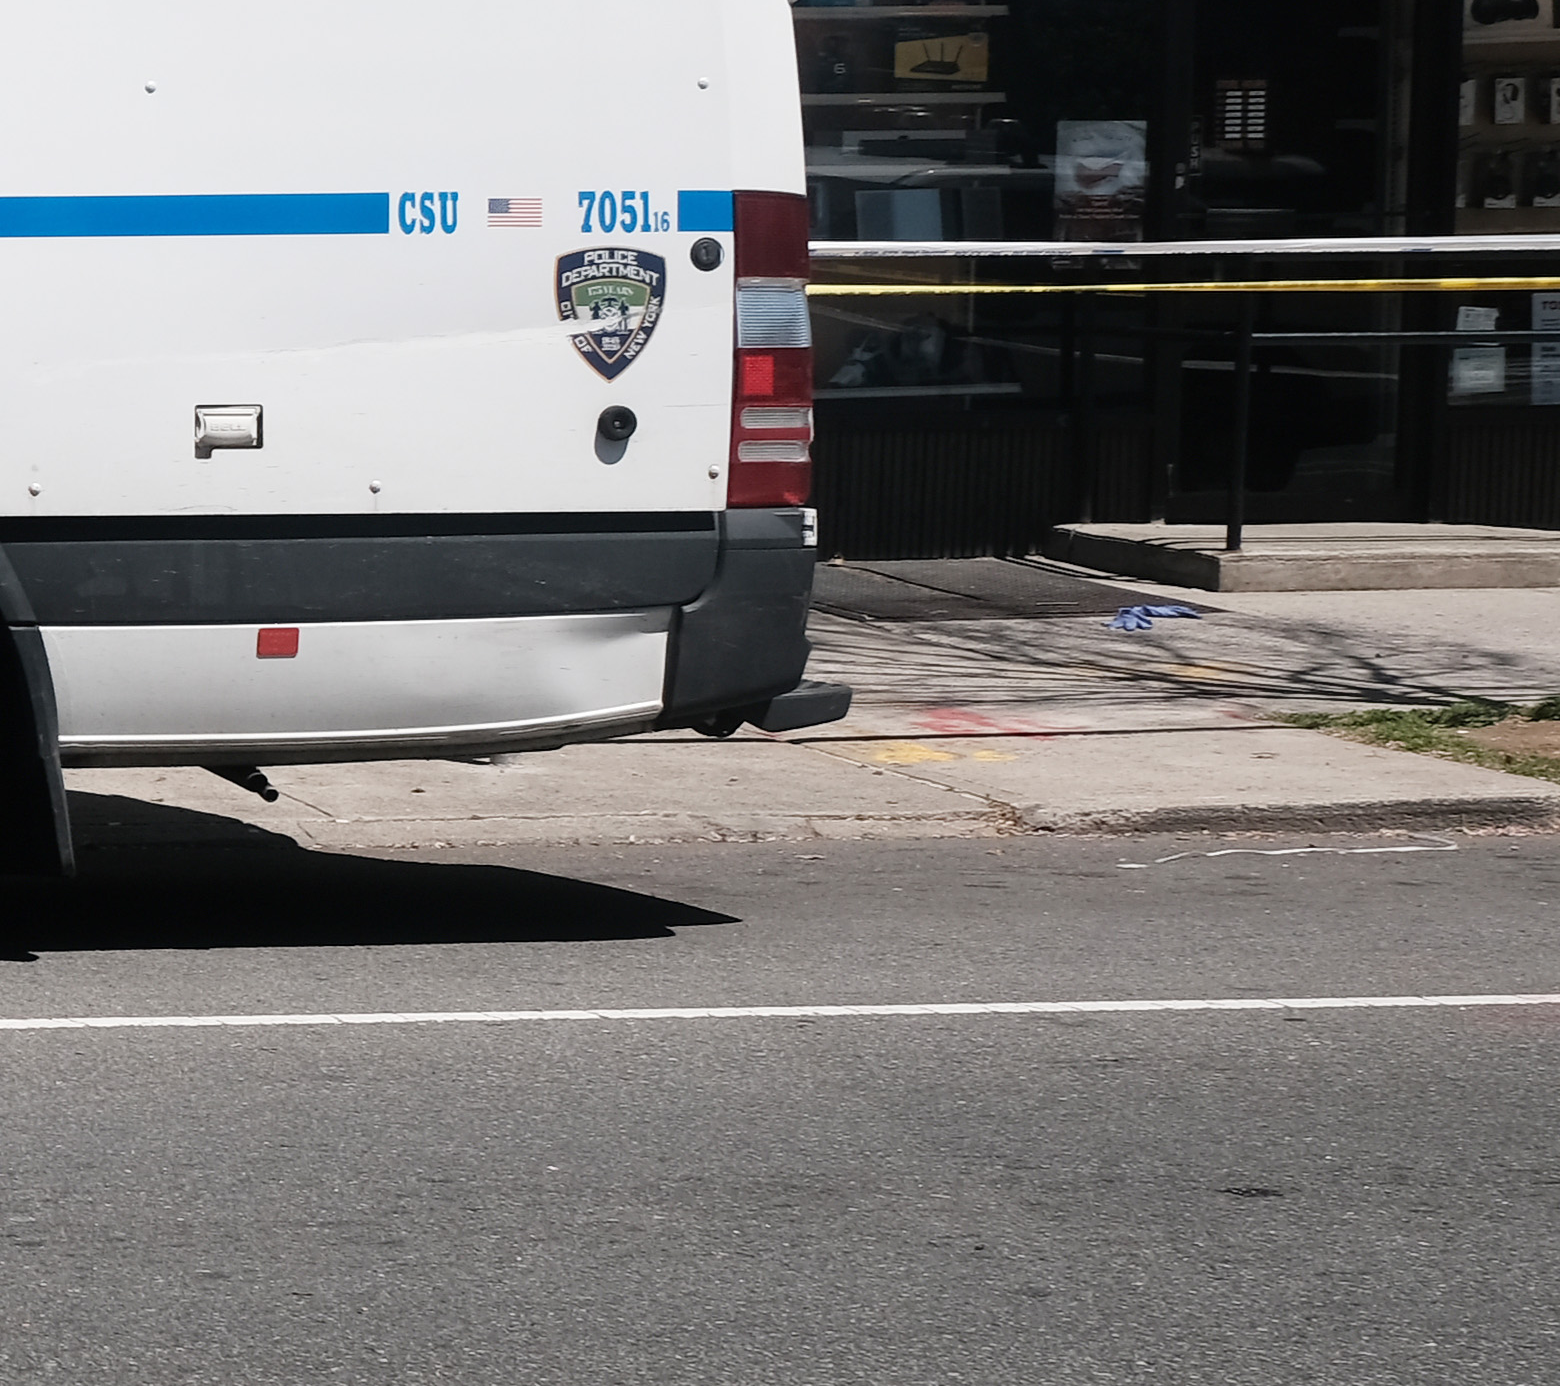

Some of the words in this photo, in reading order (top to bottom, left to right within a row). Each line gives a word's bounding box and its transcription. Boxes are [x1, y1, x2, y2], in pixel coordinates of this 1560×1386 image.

[399, 192, 459, 234] CSU
[579, 191, 651, 233] 7051
[654, 211, 670, 232] 16
[562, 264, 659, 287] DEPARTMENT
[584, 250, 638, 265] POLICE
[560, 301, 574, 319] CI
[574, 336, 593, 352] OF
[624, 331, 647, 359] NEW
[642, 296, 660, 328] YORK
